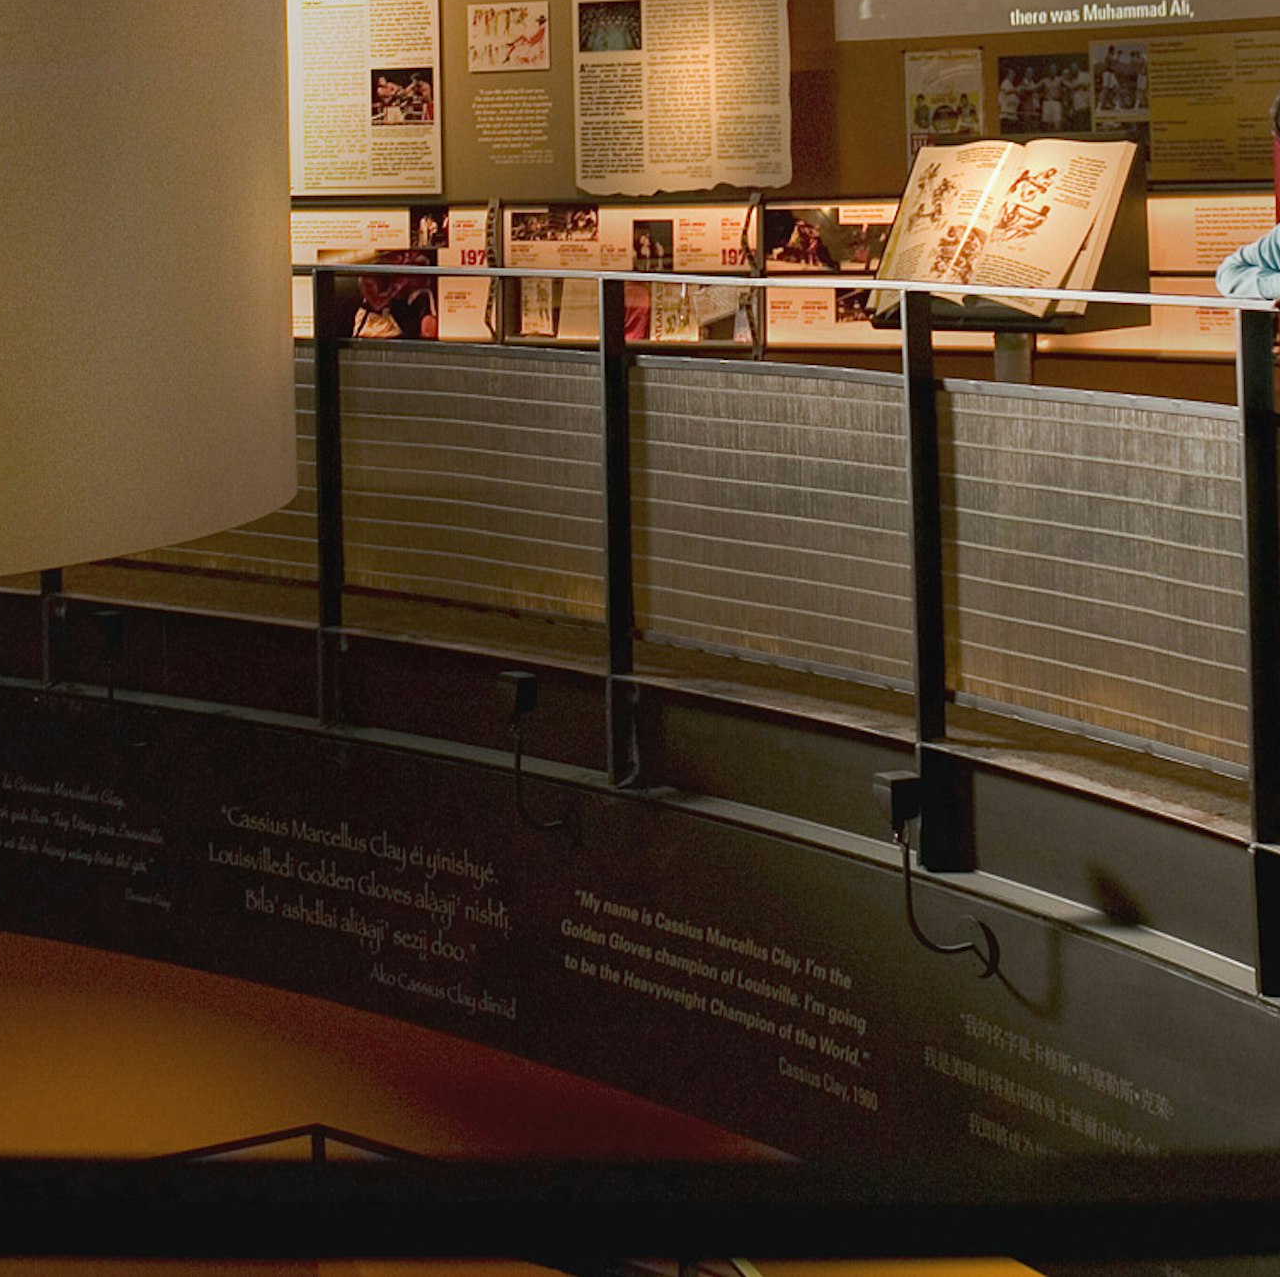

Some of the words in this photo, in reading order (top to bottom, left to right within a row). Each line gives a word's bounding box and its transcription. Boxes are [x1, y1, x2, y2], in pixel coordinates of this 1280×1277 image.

[1010, 8, 1048, 26] there
[1050, 8, 1081, 24] was
[1083, 0, 1168, 23] Muhammad
[291, 819, 368, 854] Marcellus
[369, 830, 407, 873] Clay
[297, 857, 356, 892] Golden
[358, 870, 413, 907] Gloves
[603, 900, 640, 923] name
[641, 905, 653, 925] is
[655, 911, 704, 942] Cassius
[706, 926, 769, 963] Marcellus
[771, 945, 802, 975] Clay.
[805, 956, 827, 980] I'm
[829, 966, 852, 990] the
[371, 961, 395, 987] Ako
[396, 972, 447, 1000] Cassius
[446, 983, 477, 1015] Clay
[560, 918, 606, 947] Golden
[608, 931, 653, 961] Gloves
[654, 947, 719, 982] champion
[720, 967, 735, 986] of
[736, 971, 801, 1010] Louisville.
[803, 994, 825, 1018] I'm
[828, 1007, 867, 1037] going
[564, 954, 578, 971] to
[580, 957, 597, 977] be
[599, 962, 621, 985] the
[623, 969, 707, 1014] Heavyweight
[709, 997, 776, 1035] Champion
[778, 1023, 793, 1042] of
[794, 1028, 817, 1051] the
[777, 1056, 822, 1090] Cassius
[823, 1073, 851, 1102] Clay,
[852, 1085, 878, 1112] 1960
